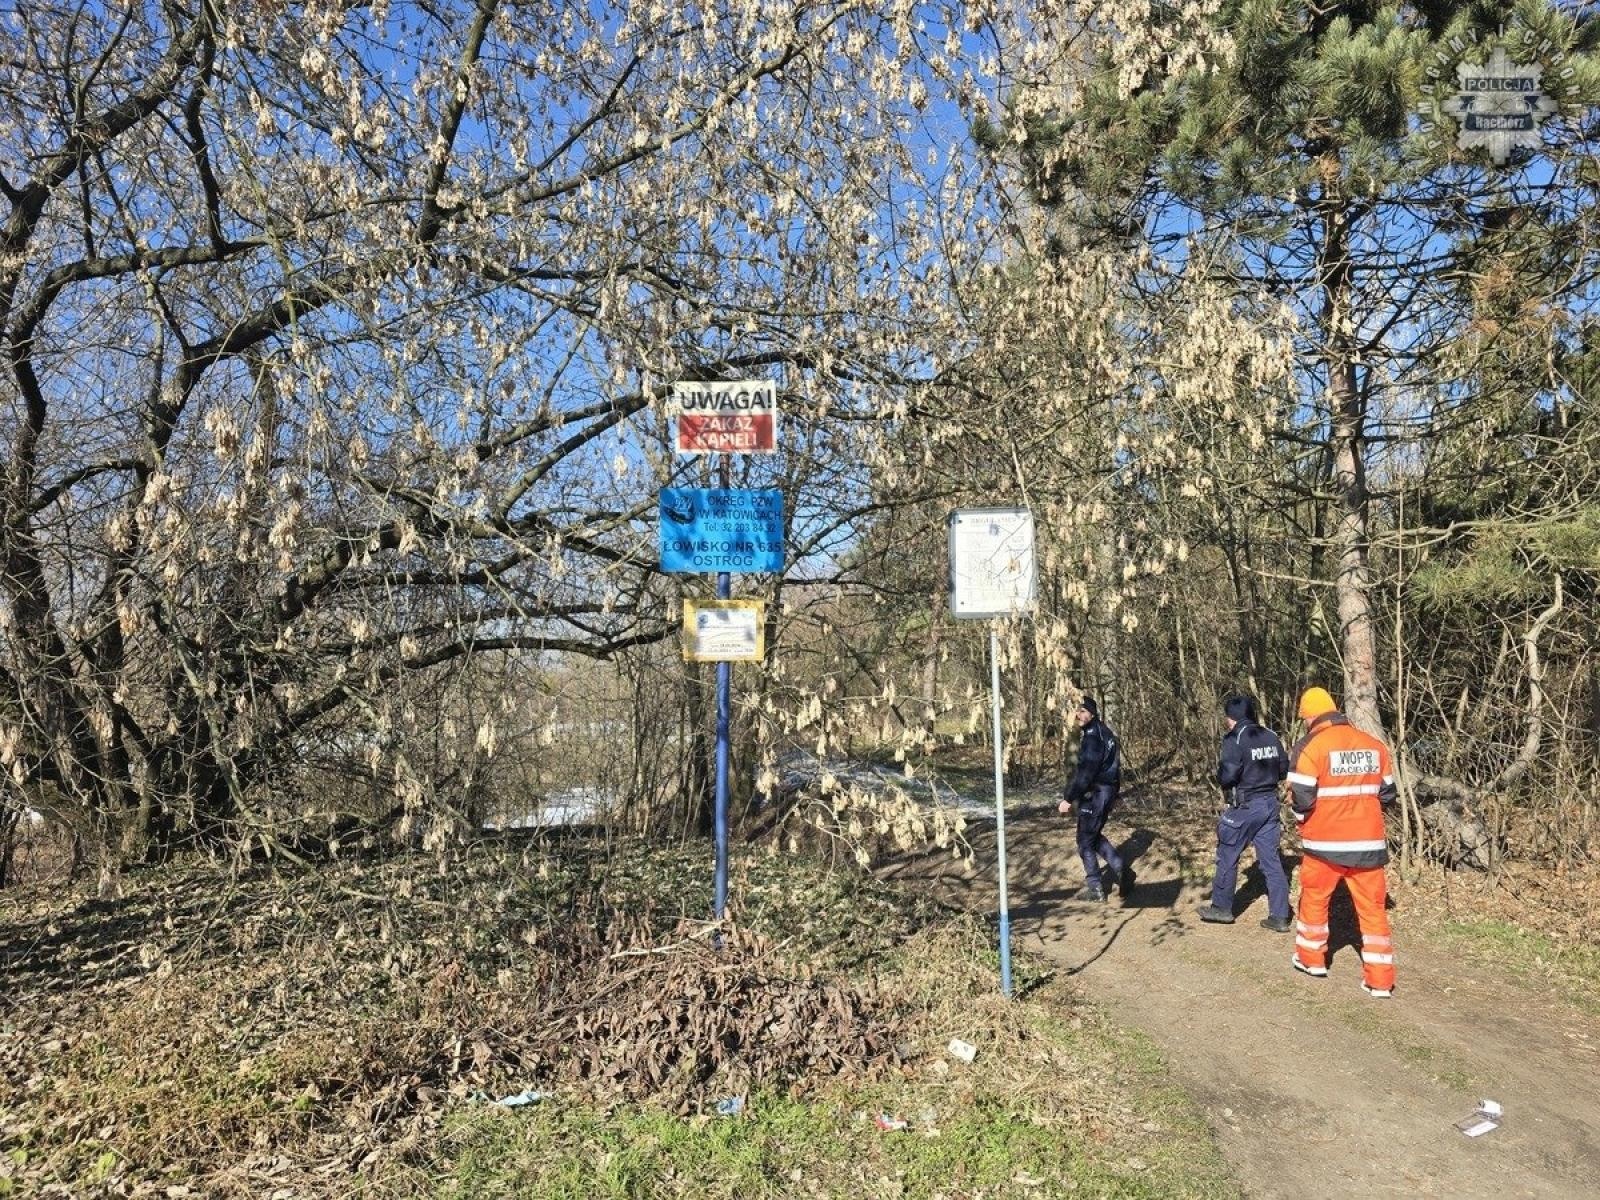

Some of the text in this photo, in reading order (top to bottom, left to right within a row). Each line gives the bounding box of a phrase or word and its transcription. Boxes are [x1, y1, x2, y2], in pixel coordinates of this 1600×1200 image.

[680, 389, 772, 409] UWAGA!
[700, 417, 754, 431] ZAKAZ
[751, 496, 774, 506] PZW
[699, 509, 781, 520] W KATOWICACH
[735, 523, 750, 532] 203
[663, 541, 781, 553] ŁOWISKO NR 635
[1339, 751, 1373, 764] WOPR
